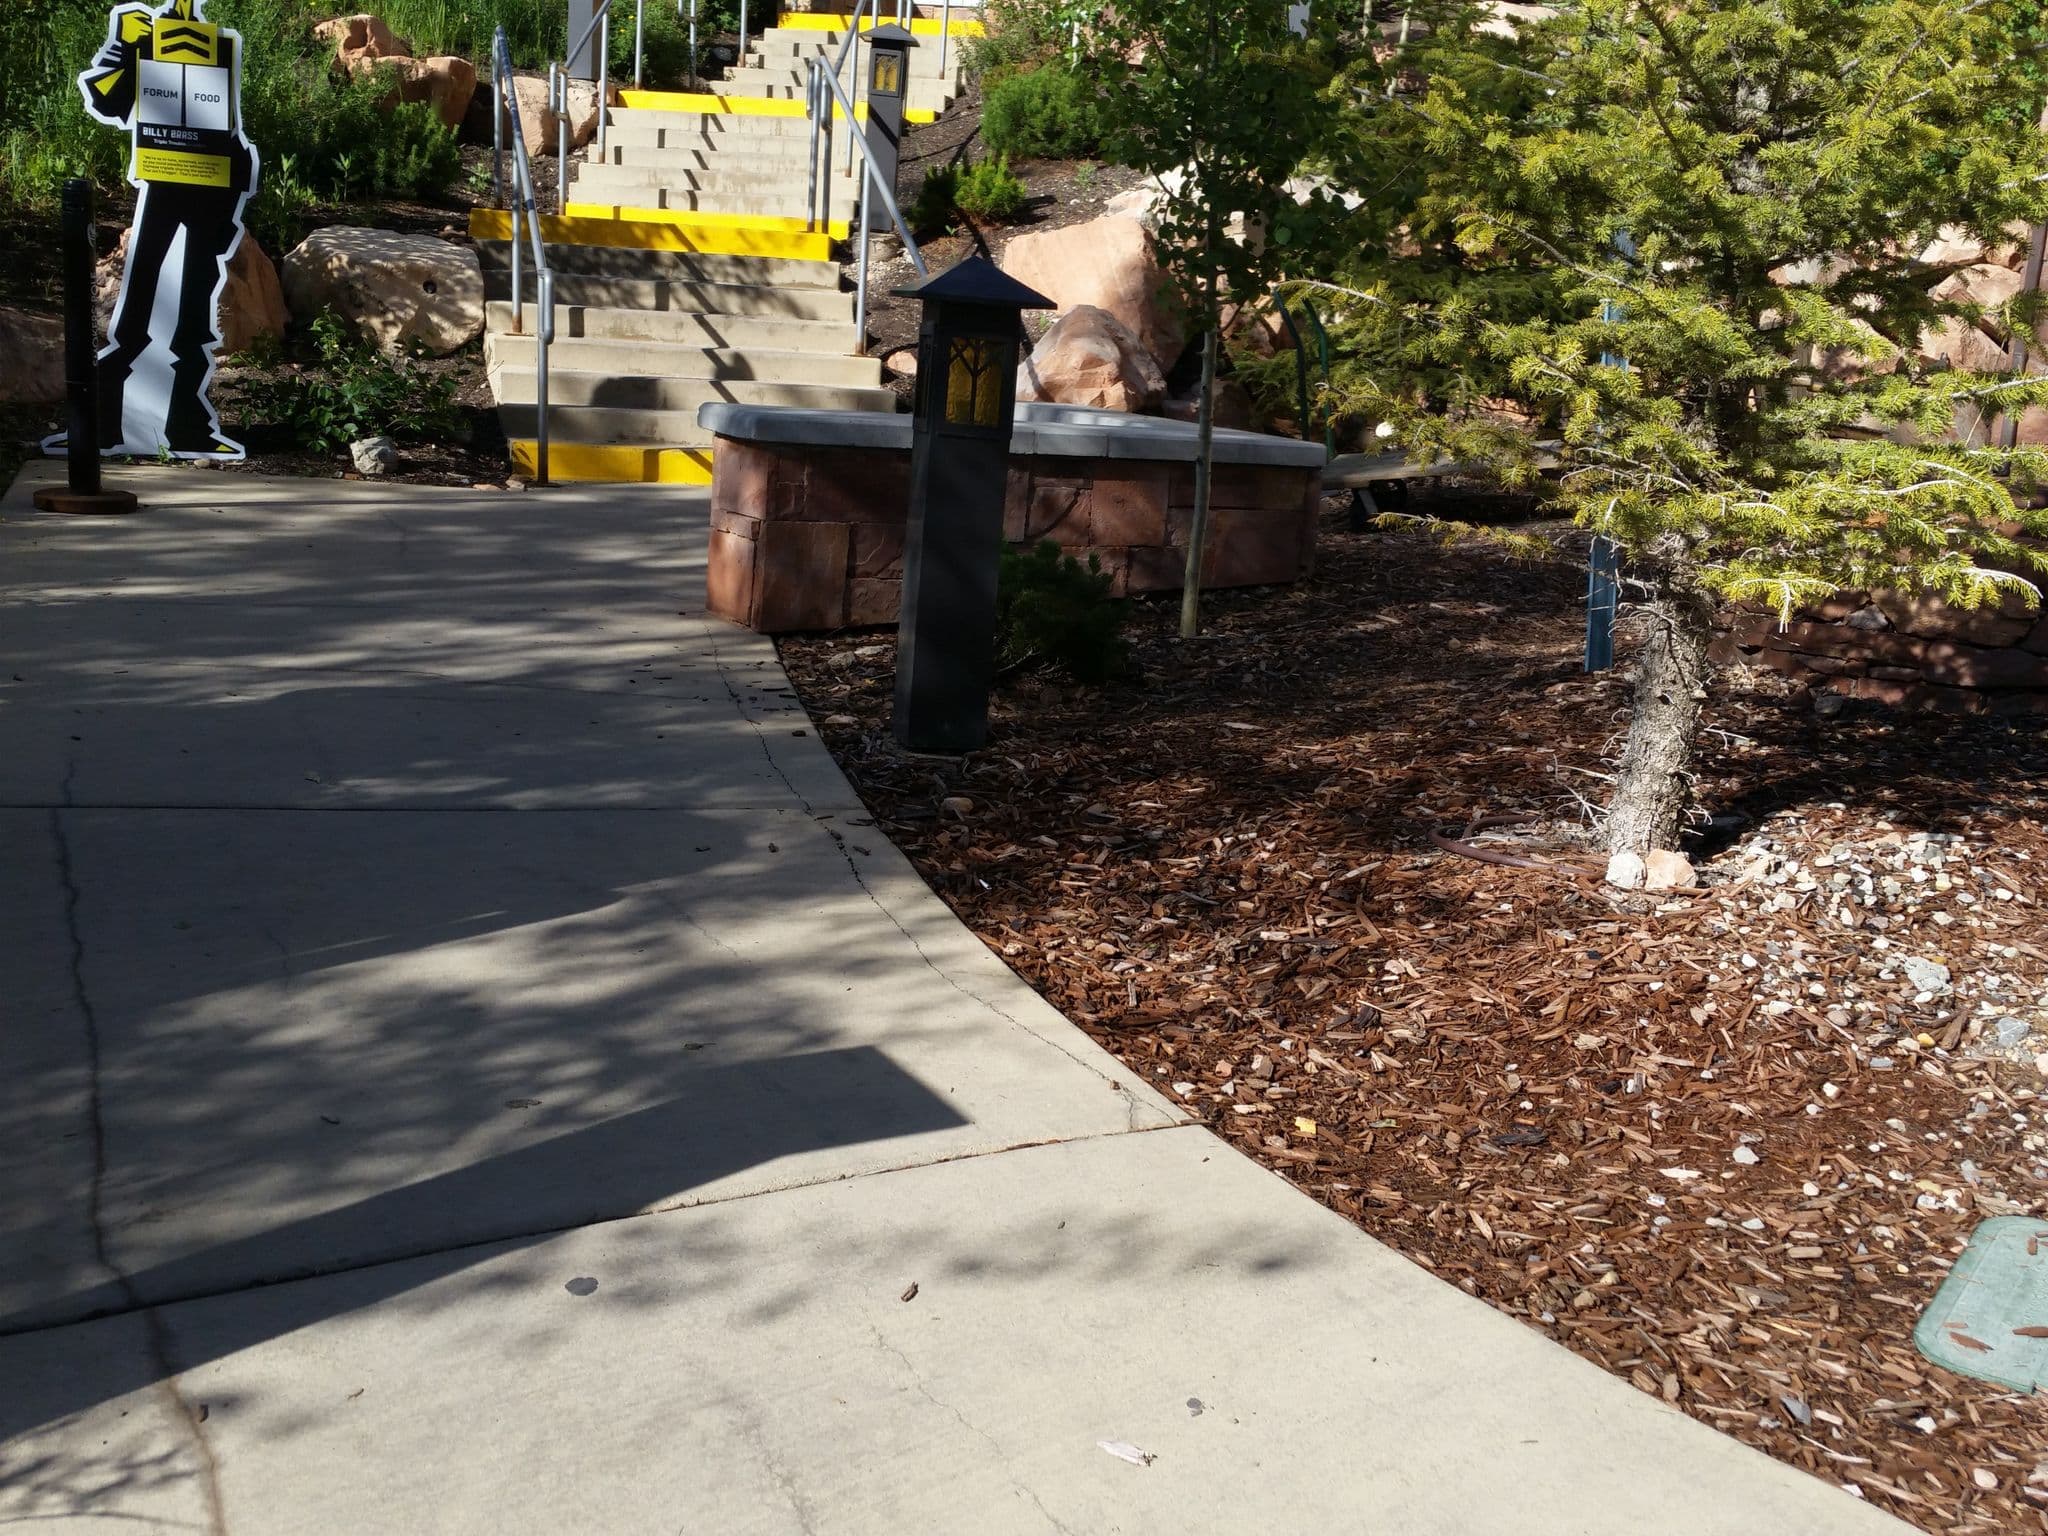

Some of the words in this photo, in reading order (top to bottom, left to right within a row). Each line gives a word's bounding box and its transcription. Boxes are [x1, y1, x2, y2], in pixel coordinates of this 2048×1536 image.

[143, 88, 178, 99] FORUM
[194, 93, 220, 103] FOOD
[142, 127, 168, 137] BILLY
[171, 131, 199, 141] BRASS
